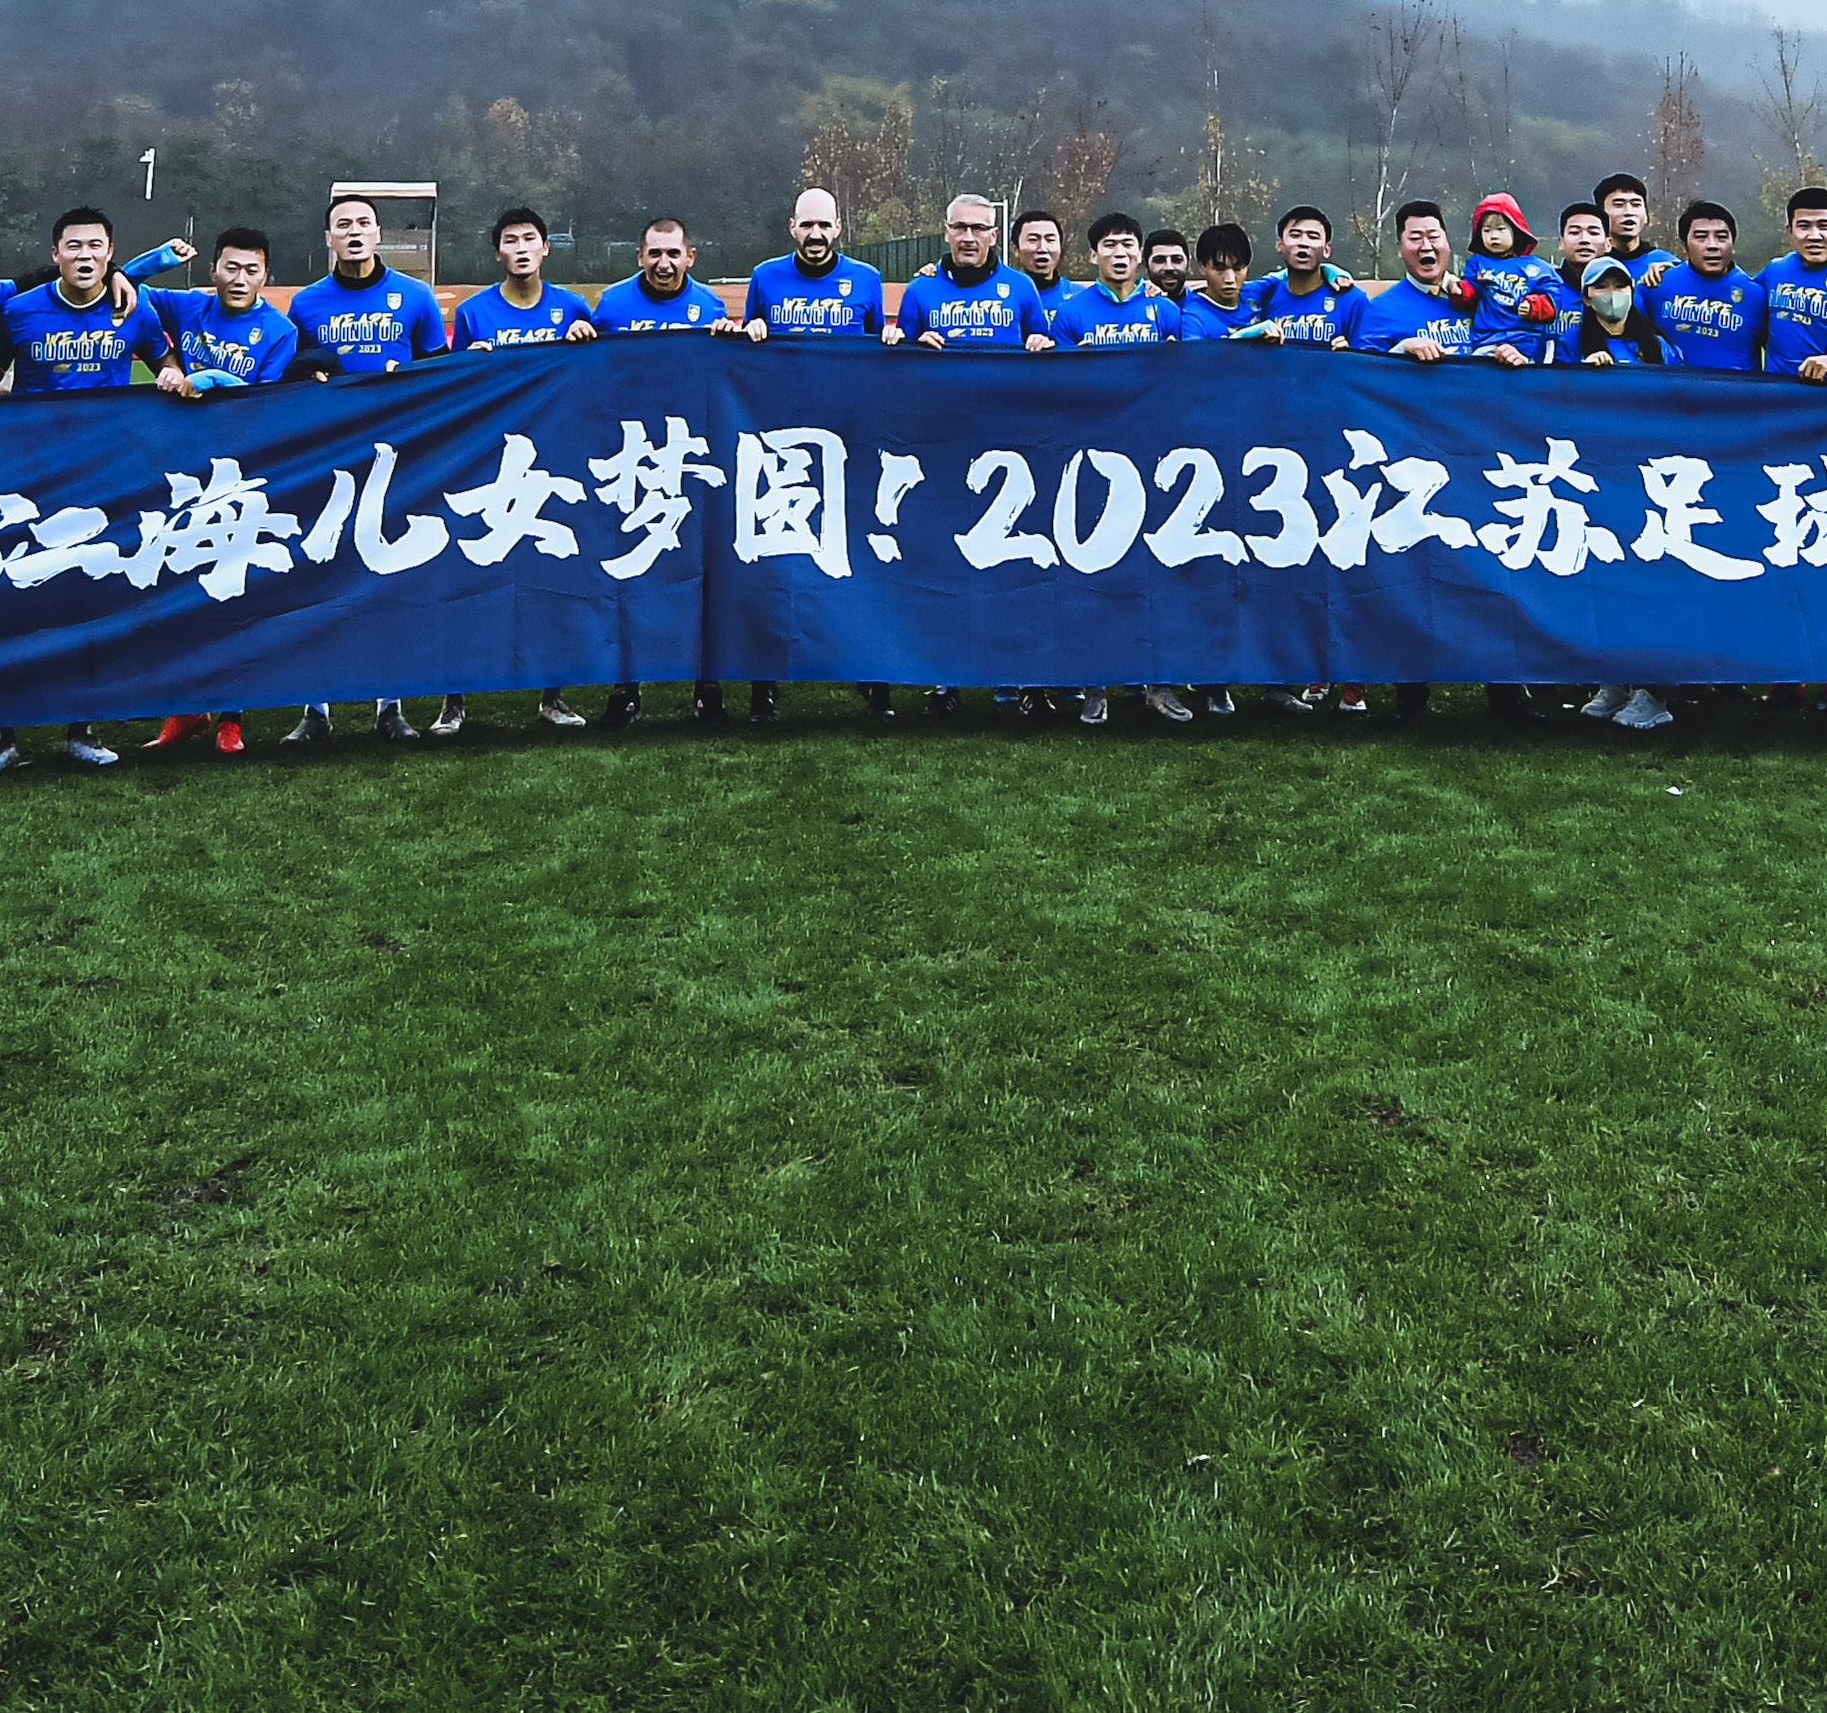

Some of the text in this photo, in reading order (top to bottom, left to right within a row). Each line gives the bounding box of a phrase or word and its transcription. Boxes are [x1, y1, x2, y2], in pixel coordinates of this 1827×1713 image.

[783, 298, 844, 312] WE ARE
[942, 300, 1002, 314] WE ARE
[1674, 295, 1733, 315] WE ARE
[330, 312, 393, 328] WE ARE
[771, 305, 853, 325] GOING UP
[930, 308, 1014, 328] GOING UP
[1296, 314, 1327, 327] ARE
[1559, 310, 1582, 324] WE
[1662, 301, 1743, 331] GOING UP
[318, 321, 403, 344] GOING UP
[1095, 323, 1152, 338] WE ARE
[1313, 323, 1336, 342] UP
[1427, 319, 1450, 332] WE
[1695, 326, 1719, 337] 2023
[46, 330, 116, 346] WE ARE
[497, 329, 522, 344] WE
[524, 328, 557, 343] ARE
[31, 340, 125, 361] GOING UP
[228, 356, 256, 377] UP
